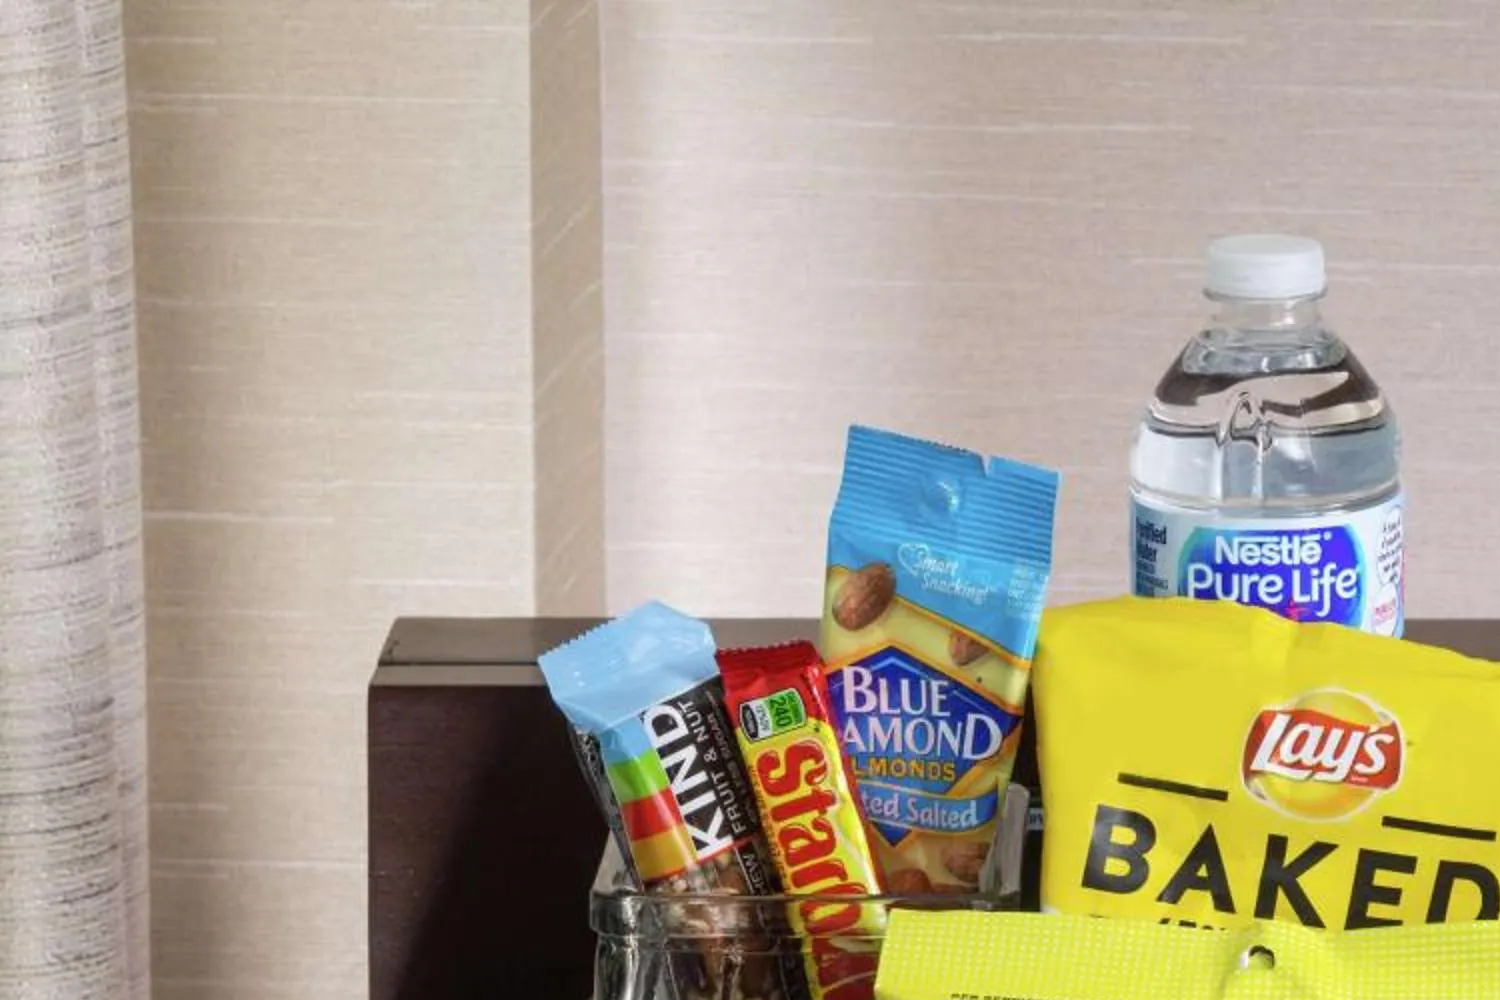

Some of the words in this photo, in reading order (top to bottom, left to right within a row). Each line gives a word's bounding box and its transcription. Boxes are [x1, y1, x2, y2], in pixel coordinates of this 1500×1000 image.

[1187, 563, 1284, 605] Pure
[1292, 562, 1360, 617] Life
[769, 698, 794, 729] 240
[843, 666, 952, 717] BLUE
[679, 701, 710, 743] NUT
[843, 713, 1004, 761] AMOND
[1250, 710, 1394, 783] Lay's
[641, 703, 734, 859] KIND
[851, 757, 956, 782] LMONDS
[711, 771, 741, 835] FRUIT
[906, 798, 978, 828] Salted
